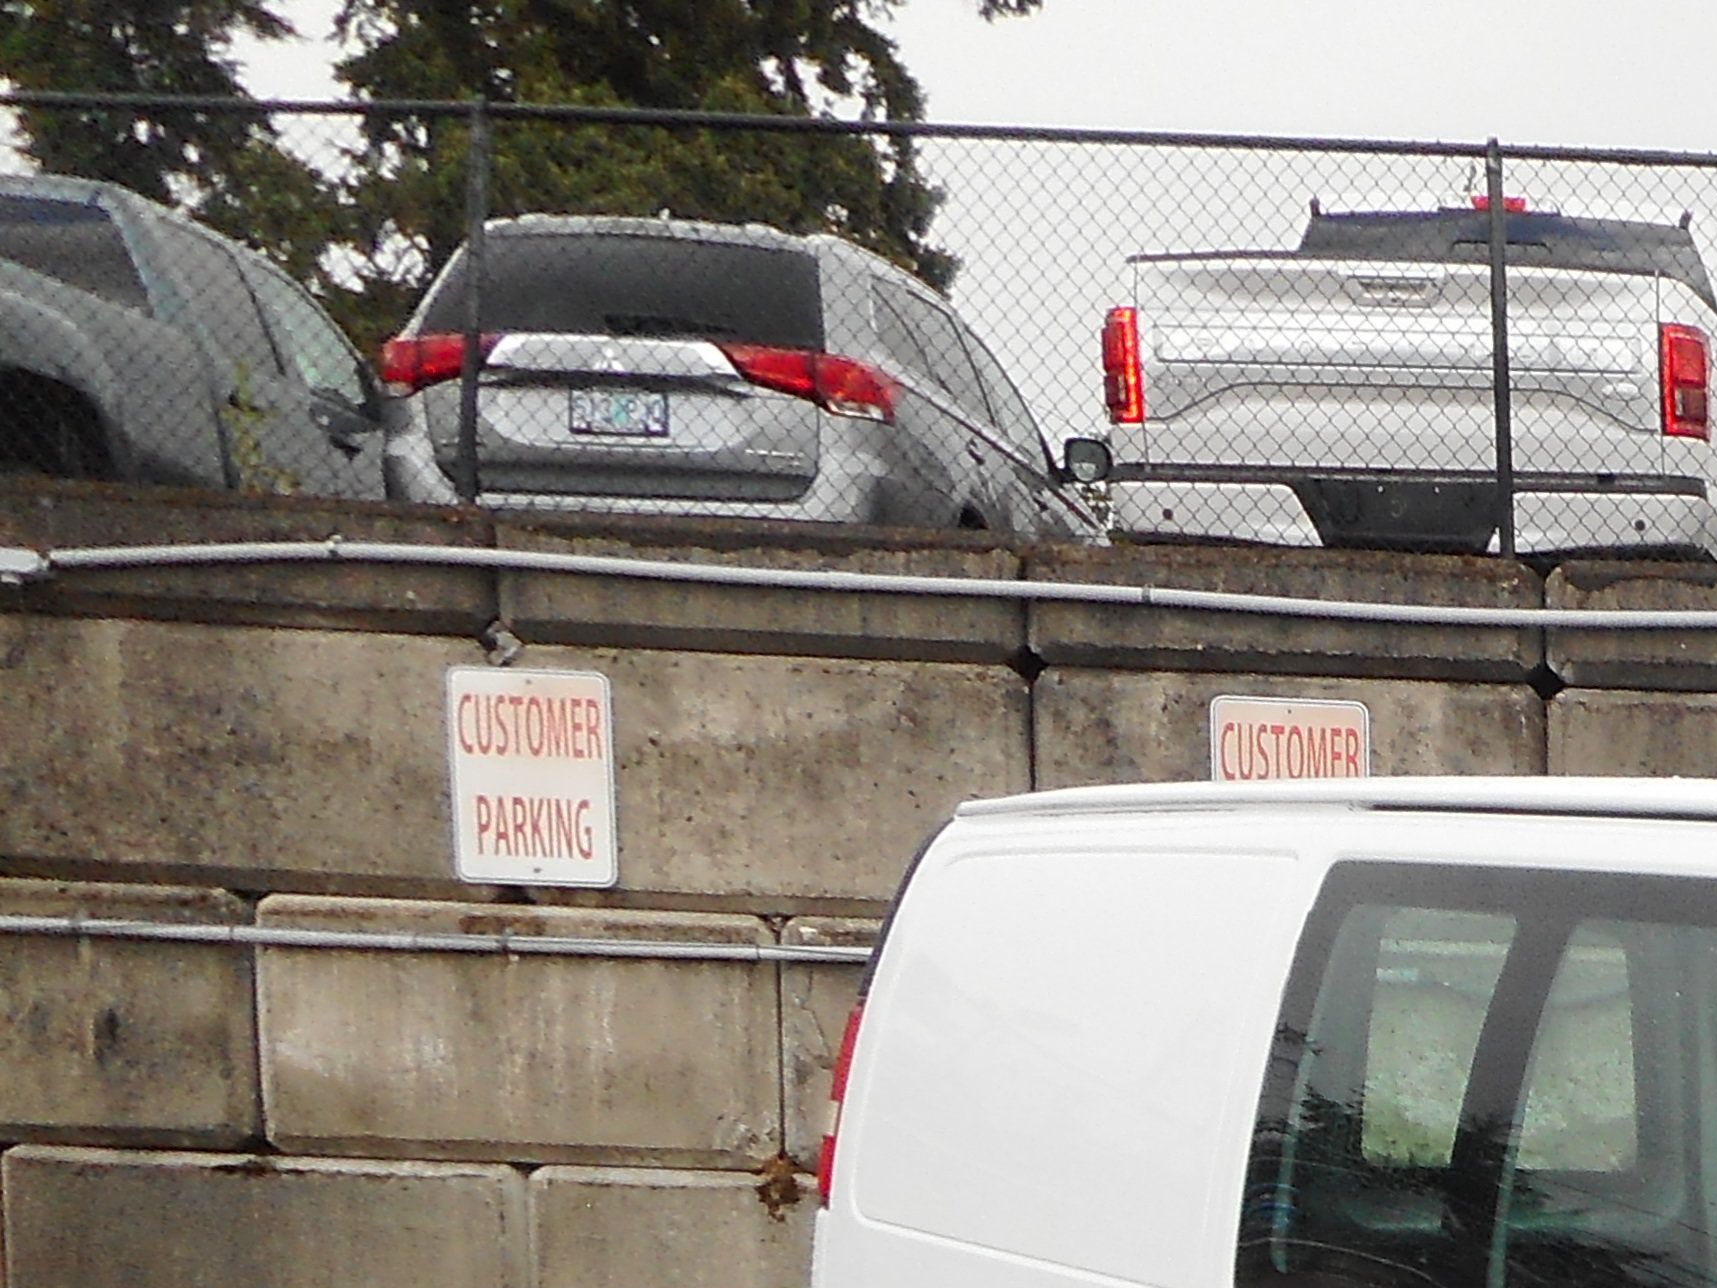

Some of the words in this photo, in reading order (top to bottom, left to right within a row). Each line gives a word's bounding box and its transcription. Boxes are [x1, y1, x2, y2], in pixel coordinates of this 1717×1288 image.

[457, 693, 603, 760] CUSTOMER
[1220, 721, 1360, 781] CUSTOMER
[475, 794, 593, 860] PARKING
